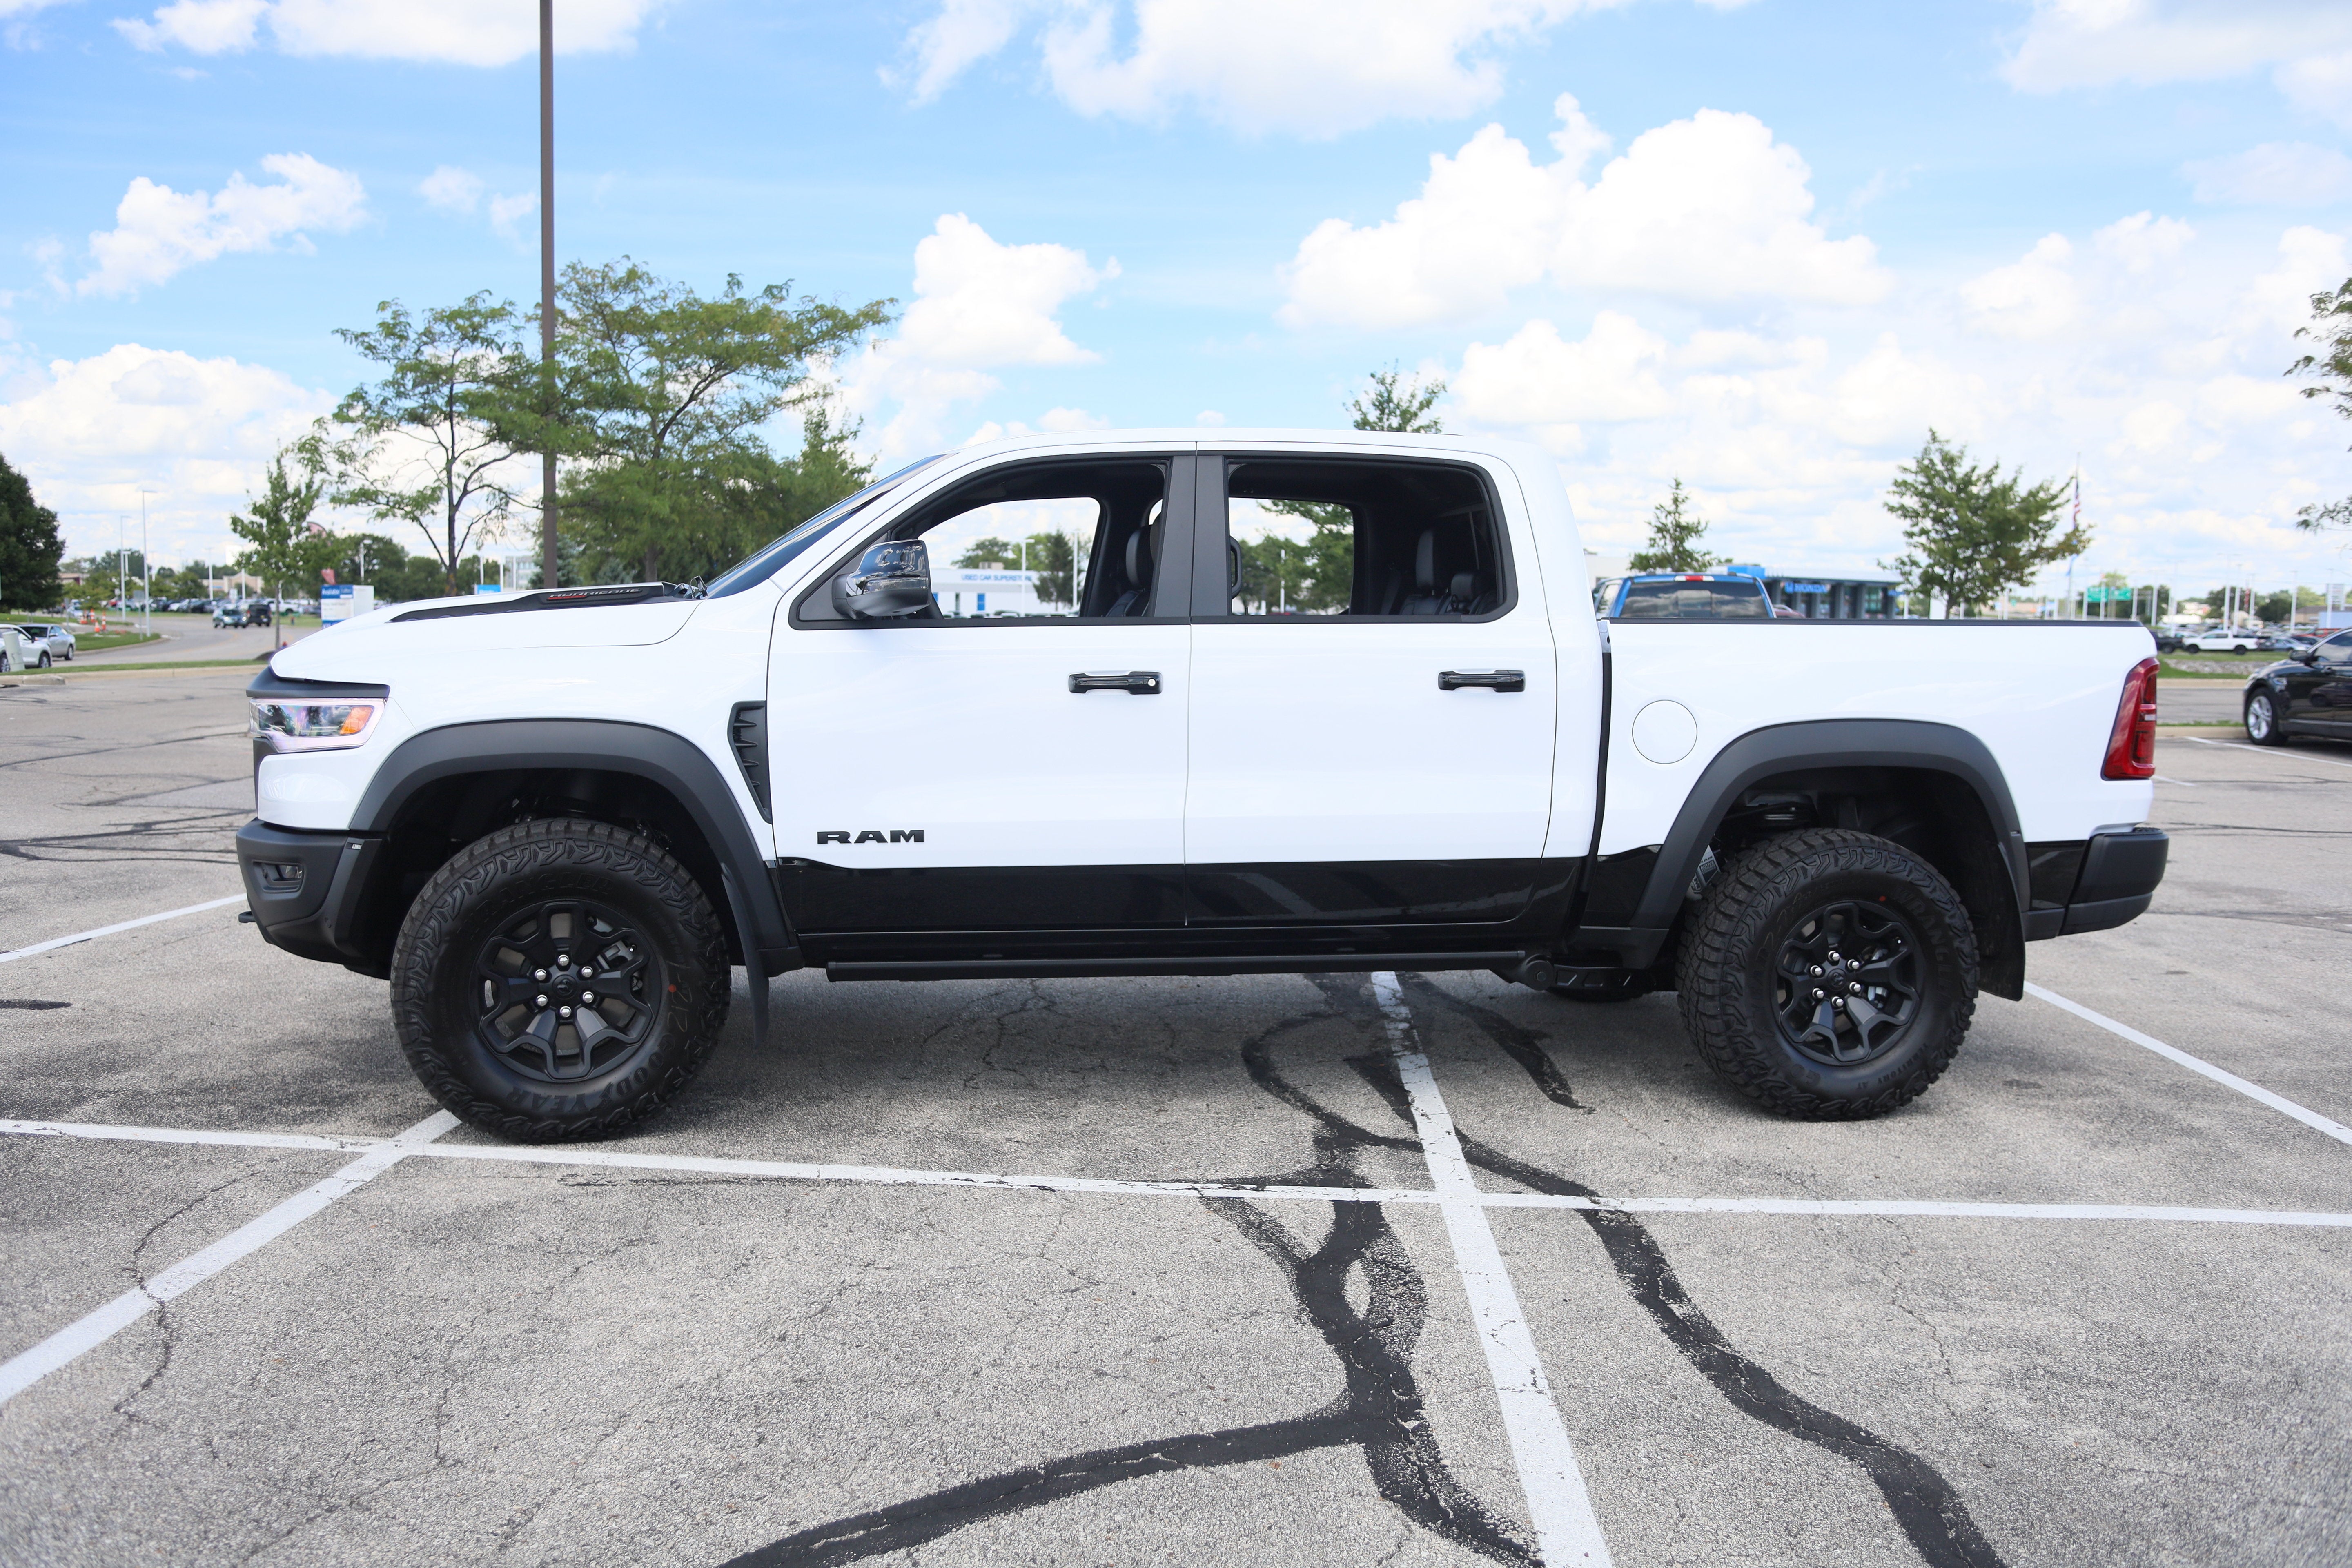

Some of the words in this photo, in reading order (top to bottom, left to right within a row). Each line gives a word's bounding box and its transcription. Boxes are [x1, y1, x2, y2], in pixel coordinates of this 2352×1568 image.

[550, 588, 640, 597] HURRICANE
[817, 829, 924, 844] RAM
[506, 1033, 676, 1112] GOODYEAR
